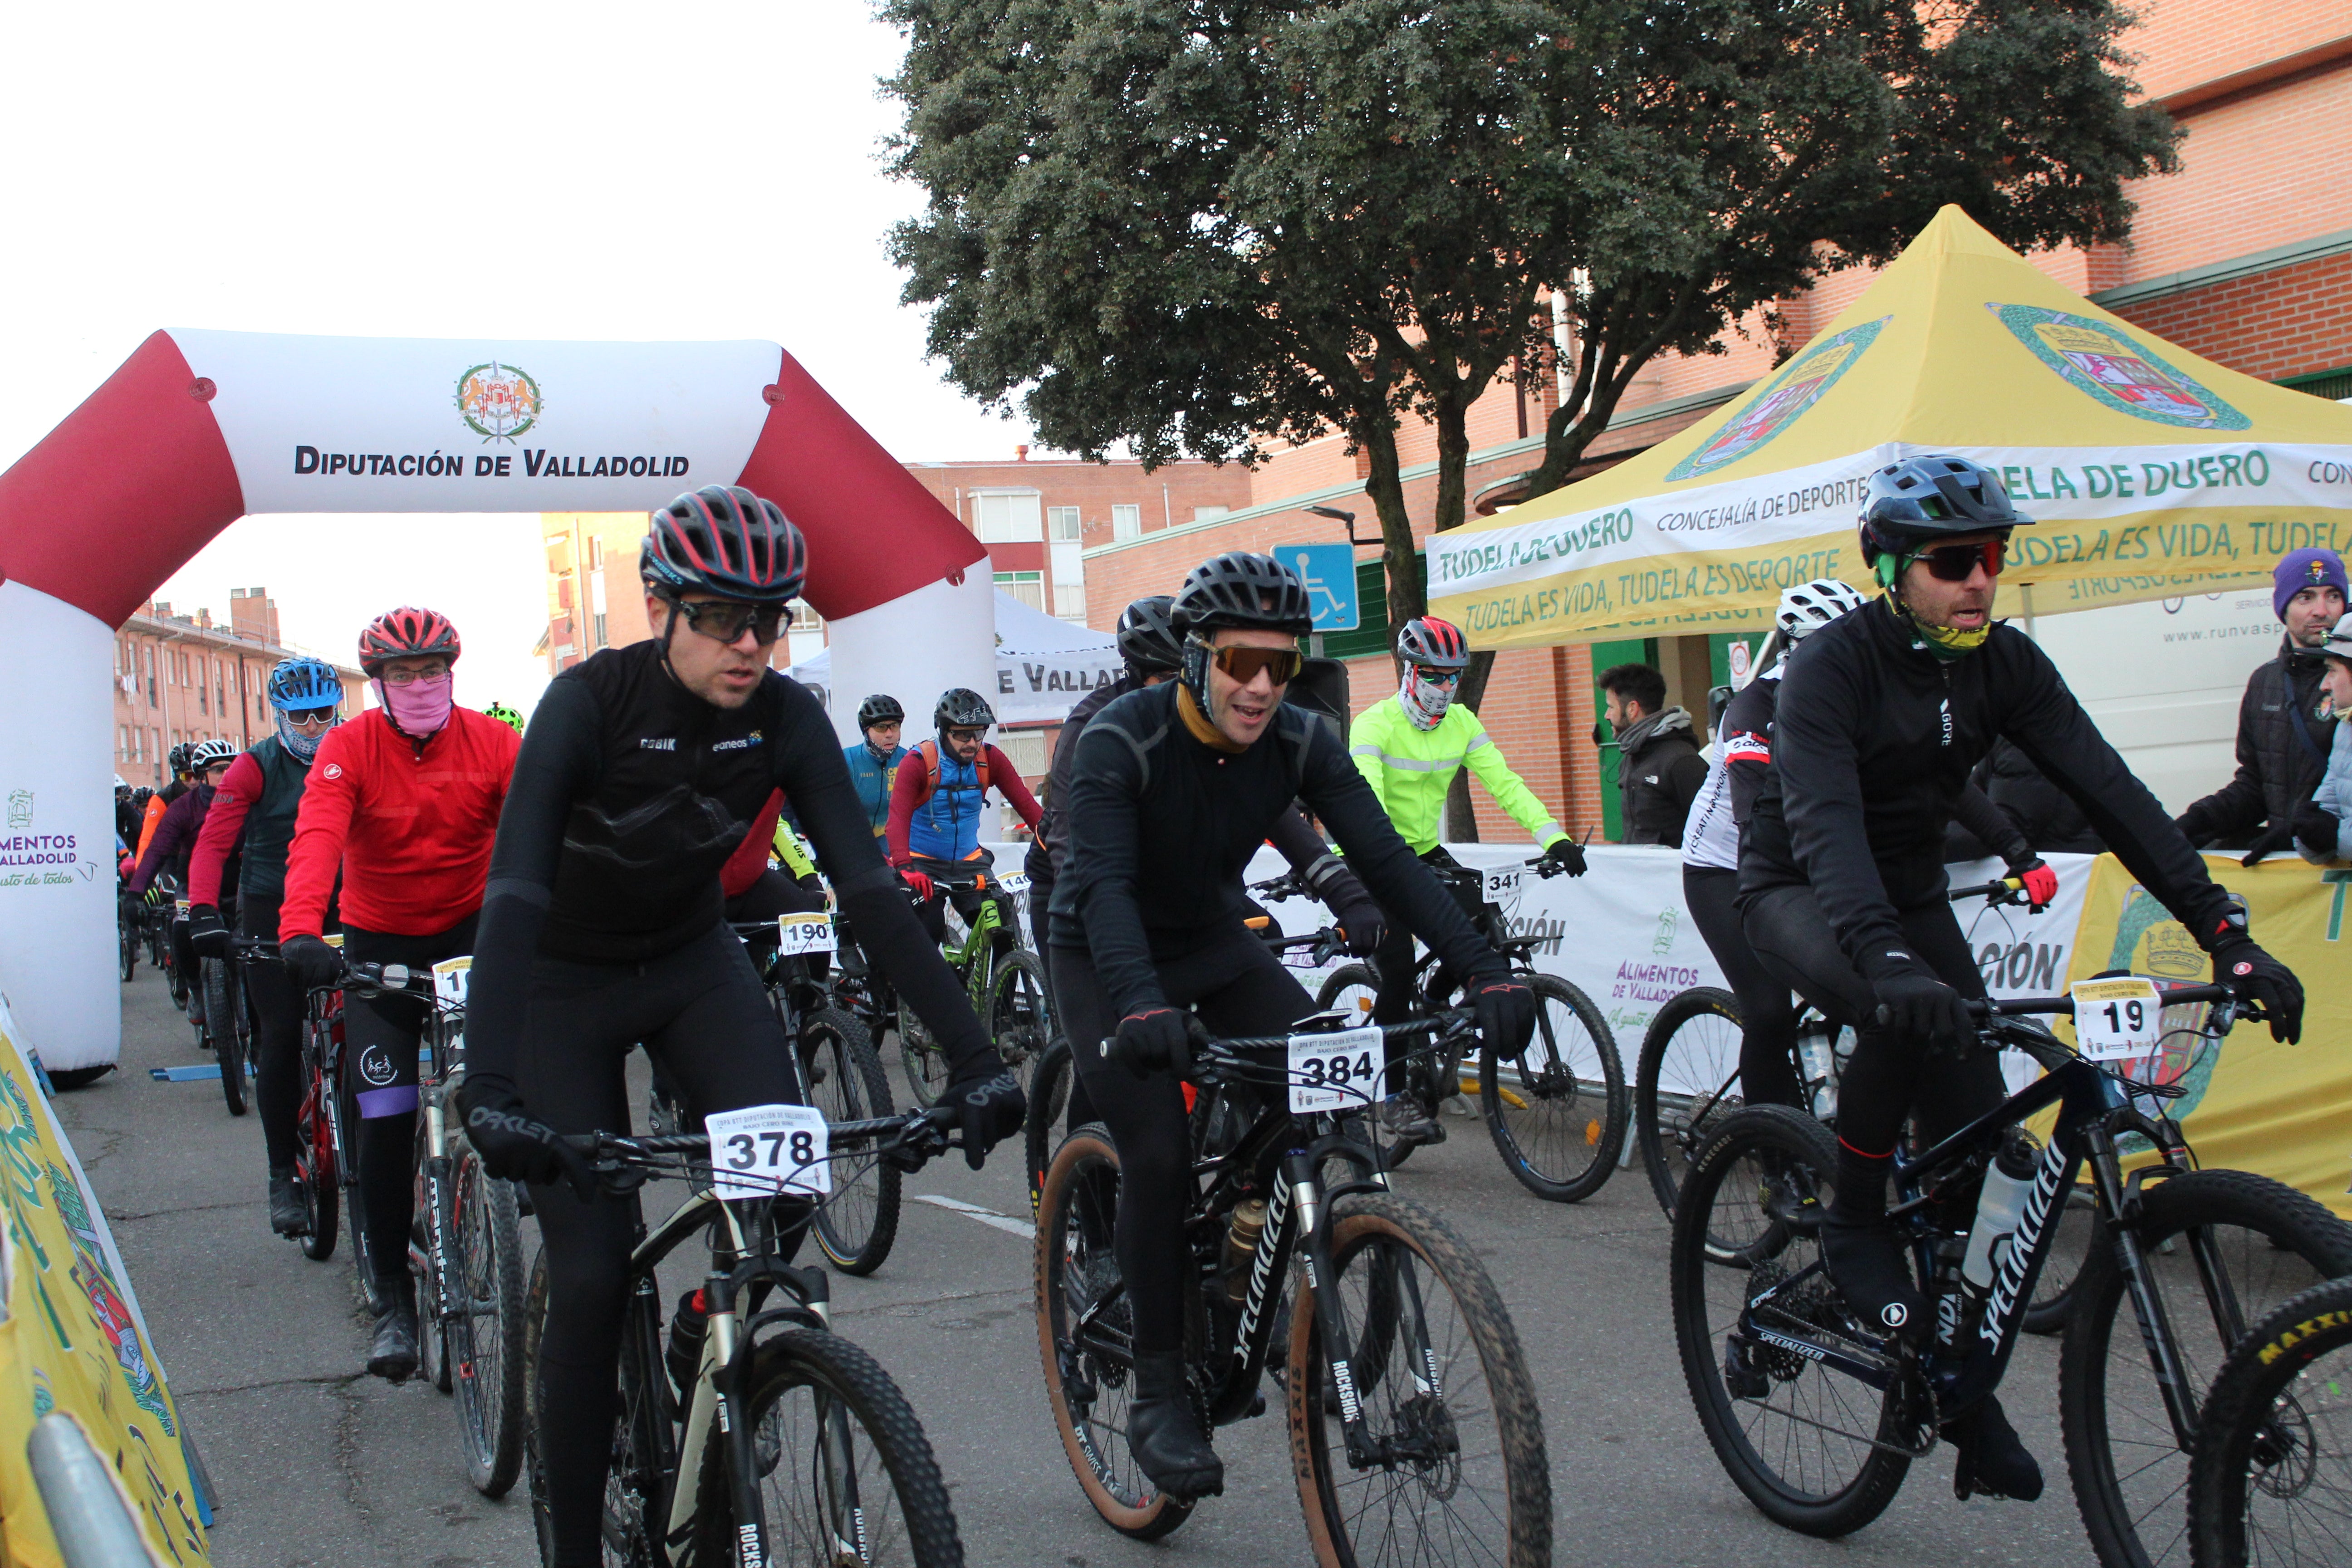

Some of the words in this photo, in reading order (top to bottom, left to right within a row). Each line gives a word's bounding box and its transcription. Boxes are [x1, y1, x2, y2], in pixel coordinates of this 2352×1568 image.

[294, 445, 463, 476] DIPUTACIÓN
[475, 456, 511, 477] DE
[523, 449, 689, 477] VALLADOLID
[1988, 466, 2079, 500] ELA
[2081, 464, 2135, 499] DE
[2141, 450, 2270, 497] DUERO
[1656, 497, 1756, 531] CONCEJALÍA
[1762, 495, 1784, 519] DE
[1788, 476, 1869, 515] DEPORTE
[2005, 529, 2110, 567] UDELA
[2113, 526, 2151, 560] ES
[2157, 522, 2239, 560] VIDA,
[1440, 542, 1520, 581] TUDELA
[1465, 594, 1535, 633] TUDELA
[1538, 589, 1558, 620] ES
[1564, 579, 1612, 613] VIDA,
[1618, 566, 1698, 606] TUDELA
[1703, 564, 1730, 596] ES
[1730, 548, 1840, 593] DEPORTE
[996, 669, 1014, 694] E
[24, 872, 41, 885] de
[44, 872, 74, 884] todos
[1489, 872, 1520, 891] 341
[788, 924, 828, 941] 190
[1301, 953, 1337, 968] VALLOLID
[1616, 958, 1699, 986] ALIMENTOS
[1968, 931, 2063, 990] CIÓN
[446, 970, 471, 992] 1
[1612, 984, 1626, 998] DE
[1629, 982, 1681, 1003] VALLADO
[2102, 1000, 2143, 1033] 19
[1302, 1051, 1374, 1088] 384
[727, 1131, 813, 1170] 378
[1697, 1133, 1734, 1172] RENEGADE
[1759, 1332, 1826, 1361] SPECIALIZED
[1083, 1445, 1102, 1475] SWISS
